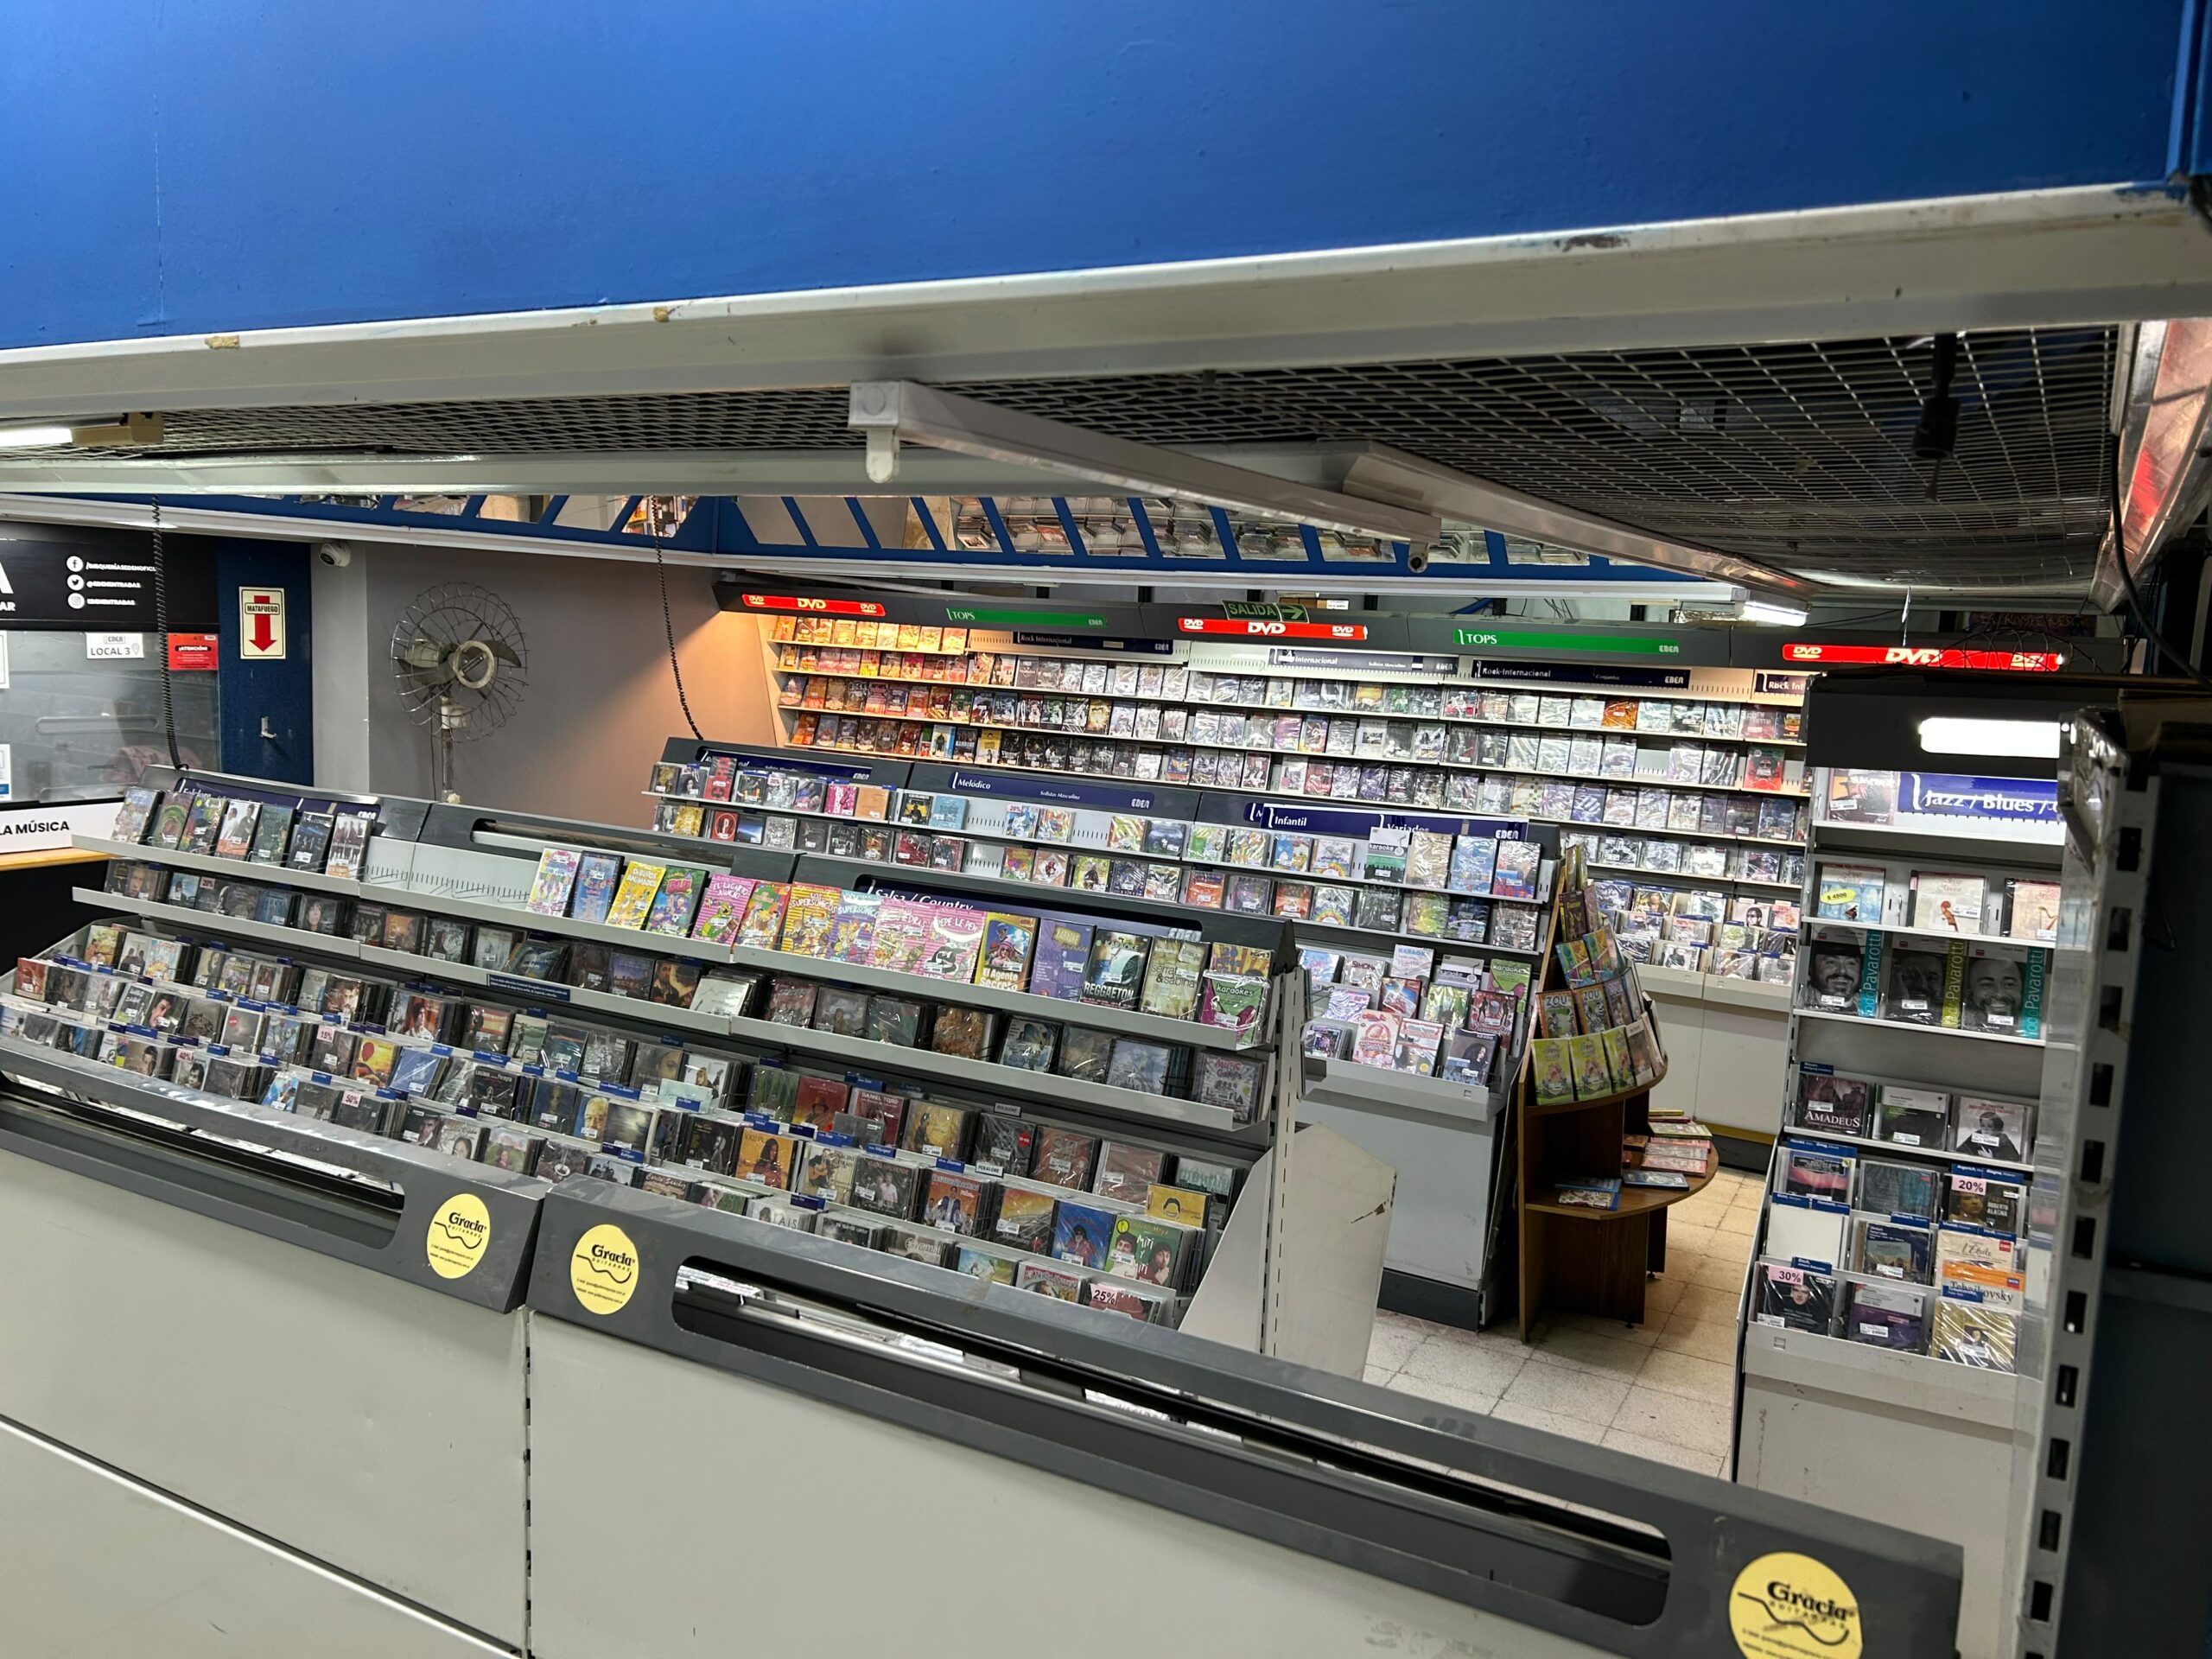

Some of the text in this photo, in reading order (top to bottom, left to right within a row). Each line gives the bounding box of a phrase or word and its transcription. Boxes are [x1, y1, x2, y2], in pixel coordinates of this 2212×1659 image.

[797, 598, 827, 610] DVD
[1228, 604, 1277, 616] SALIDA
[952, 610, 976, 621] TOPS
[1248, 622, 1287, 635] DVD
[1036, 636, 1072, 645] Internacional
[1467, 633, 1497, 645] TOPS
[1793, 646, 1822, 656] DVD
[1885, 648, 1943, 664] DVD
[1295, 657, 1338, 665] Internacional
[1769, 681, 1789, 690] Rock
[957, 779, 992, 790] Melódico
[1925, 791, 1964, 807] Jazz
[1982, 796, 2034, 812] Blues
[1274, 816, 1307, 826] Infantil
[16, 820, 70, 835] MÚSICA
[1370, 843, 1395, 852] karaoke
[875, 889, 906, 901] Salsa
[919, 895, 974, 910] Country
[1864, 933, 1882, 992] Pavarotti
[991, 969, 1019, 981] Agente
[1946, 939, 1965, 1000] Pavarotti
[2025, 949, 2045, 1009] Pavarotti
[1084, 982, 1135, 1000] REGGAETON
[1217, 983, 1254, 997] karaokes
[1584, 989, 1599, 1001] ZOU
[1547, 995, 1567, 1007] ZOU
[346, 1095, 359, 1104] 50%
[1959, 1180, 1984, 1192] 20%
[448, 1211, 484, 1233] Gracia
[591, 1244, 632, 1267] Gracia
[1779, 1270, 1802, 1283] 30%
[1093, 1289, 1116, 1304] 25%
[1767, 1580, 1847, 1620] Gracia
